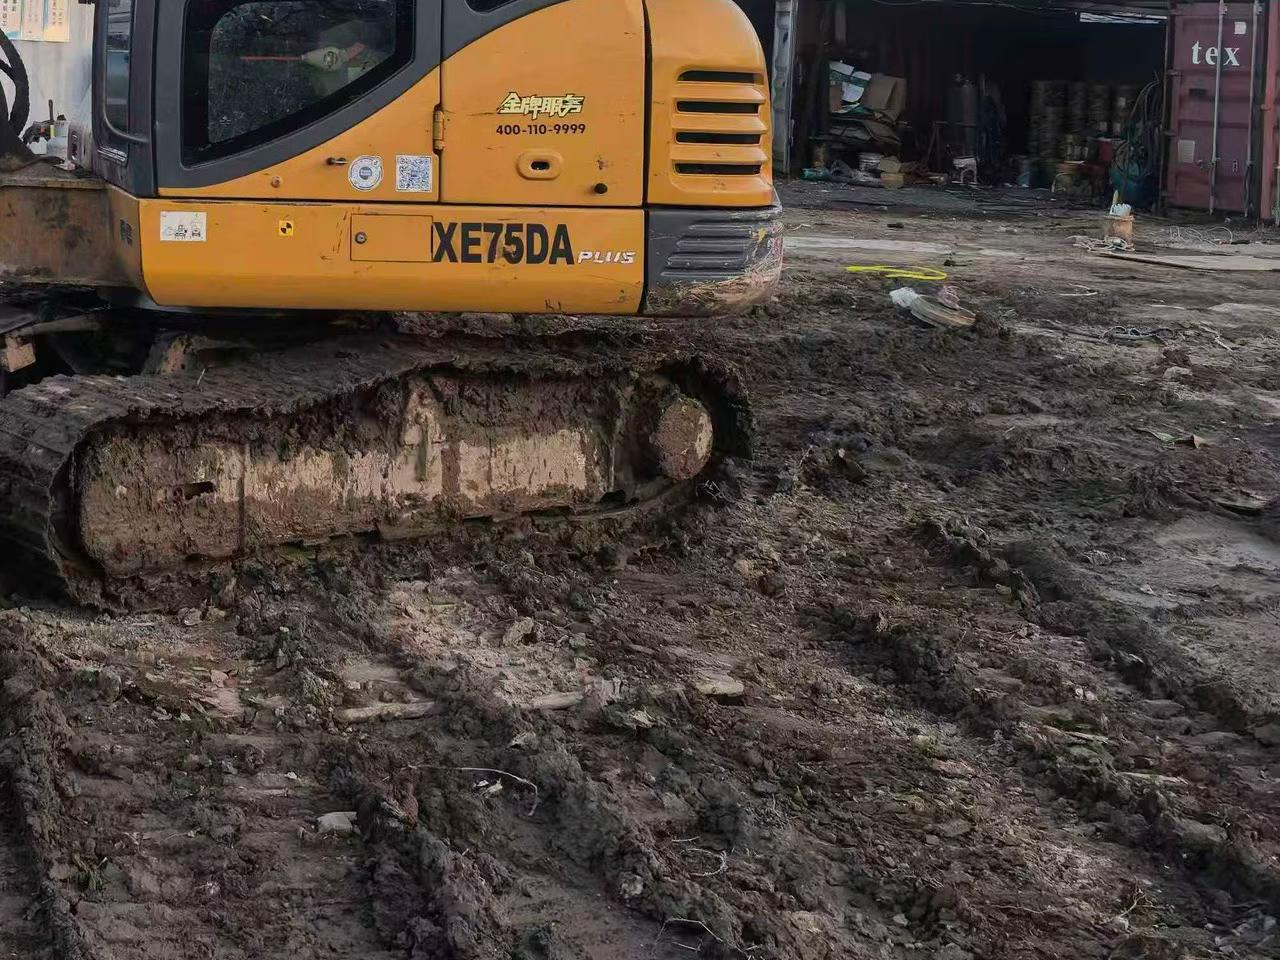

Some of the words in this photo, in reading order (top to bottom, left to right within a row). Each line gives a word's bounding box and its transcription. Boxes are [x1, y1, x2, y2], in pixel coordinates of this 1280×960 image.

[1192, 40, 1240, 66] tex
[497, 91, 585, 120] 金牌服务
[496, 124, 586, 135] 400-110-9999
[432, 222, 574, 265] XE75DA
[578, 251, 636, 264] PLUS
